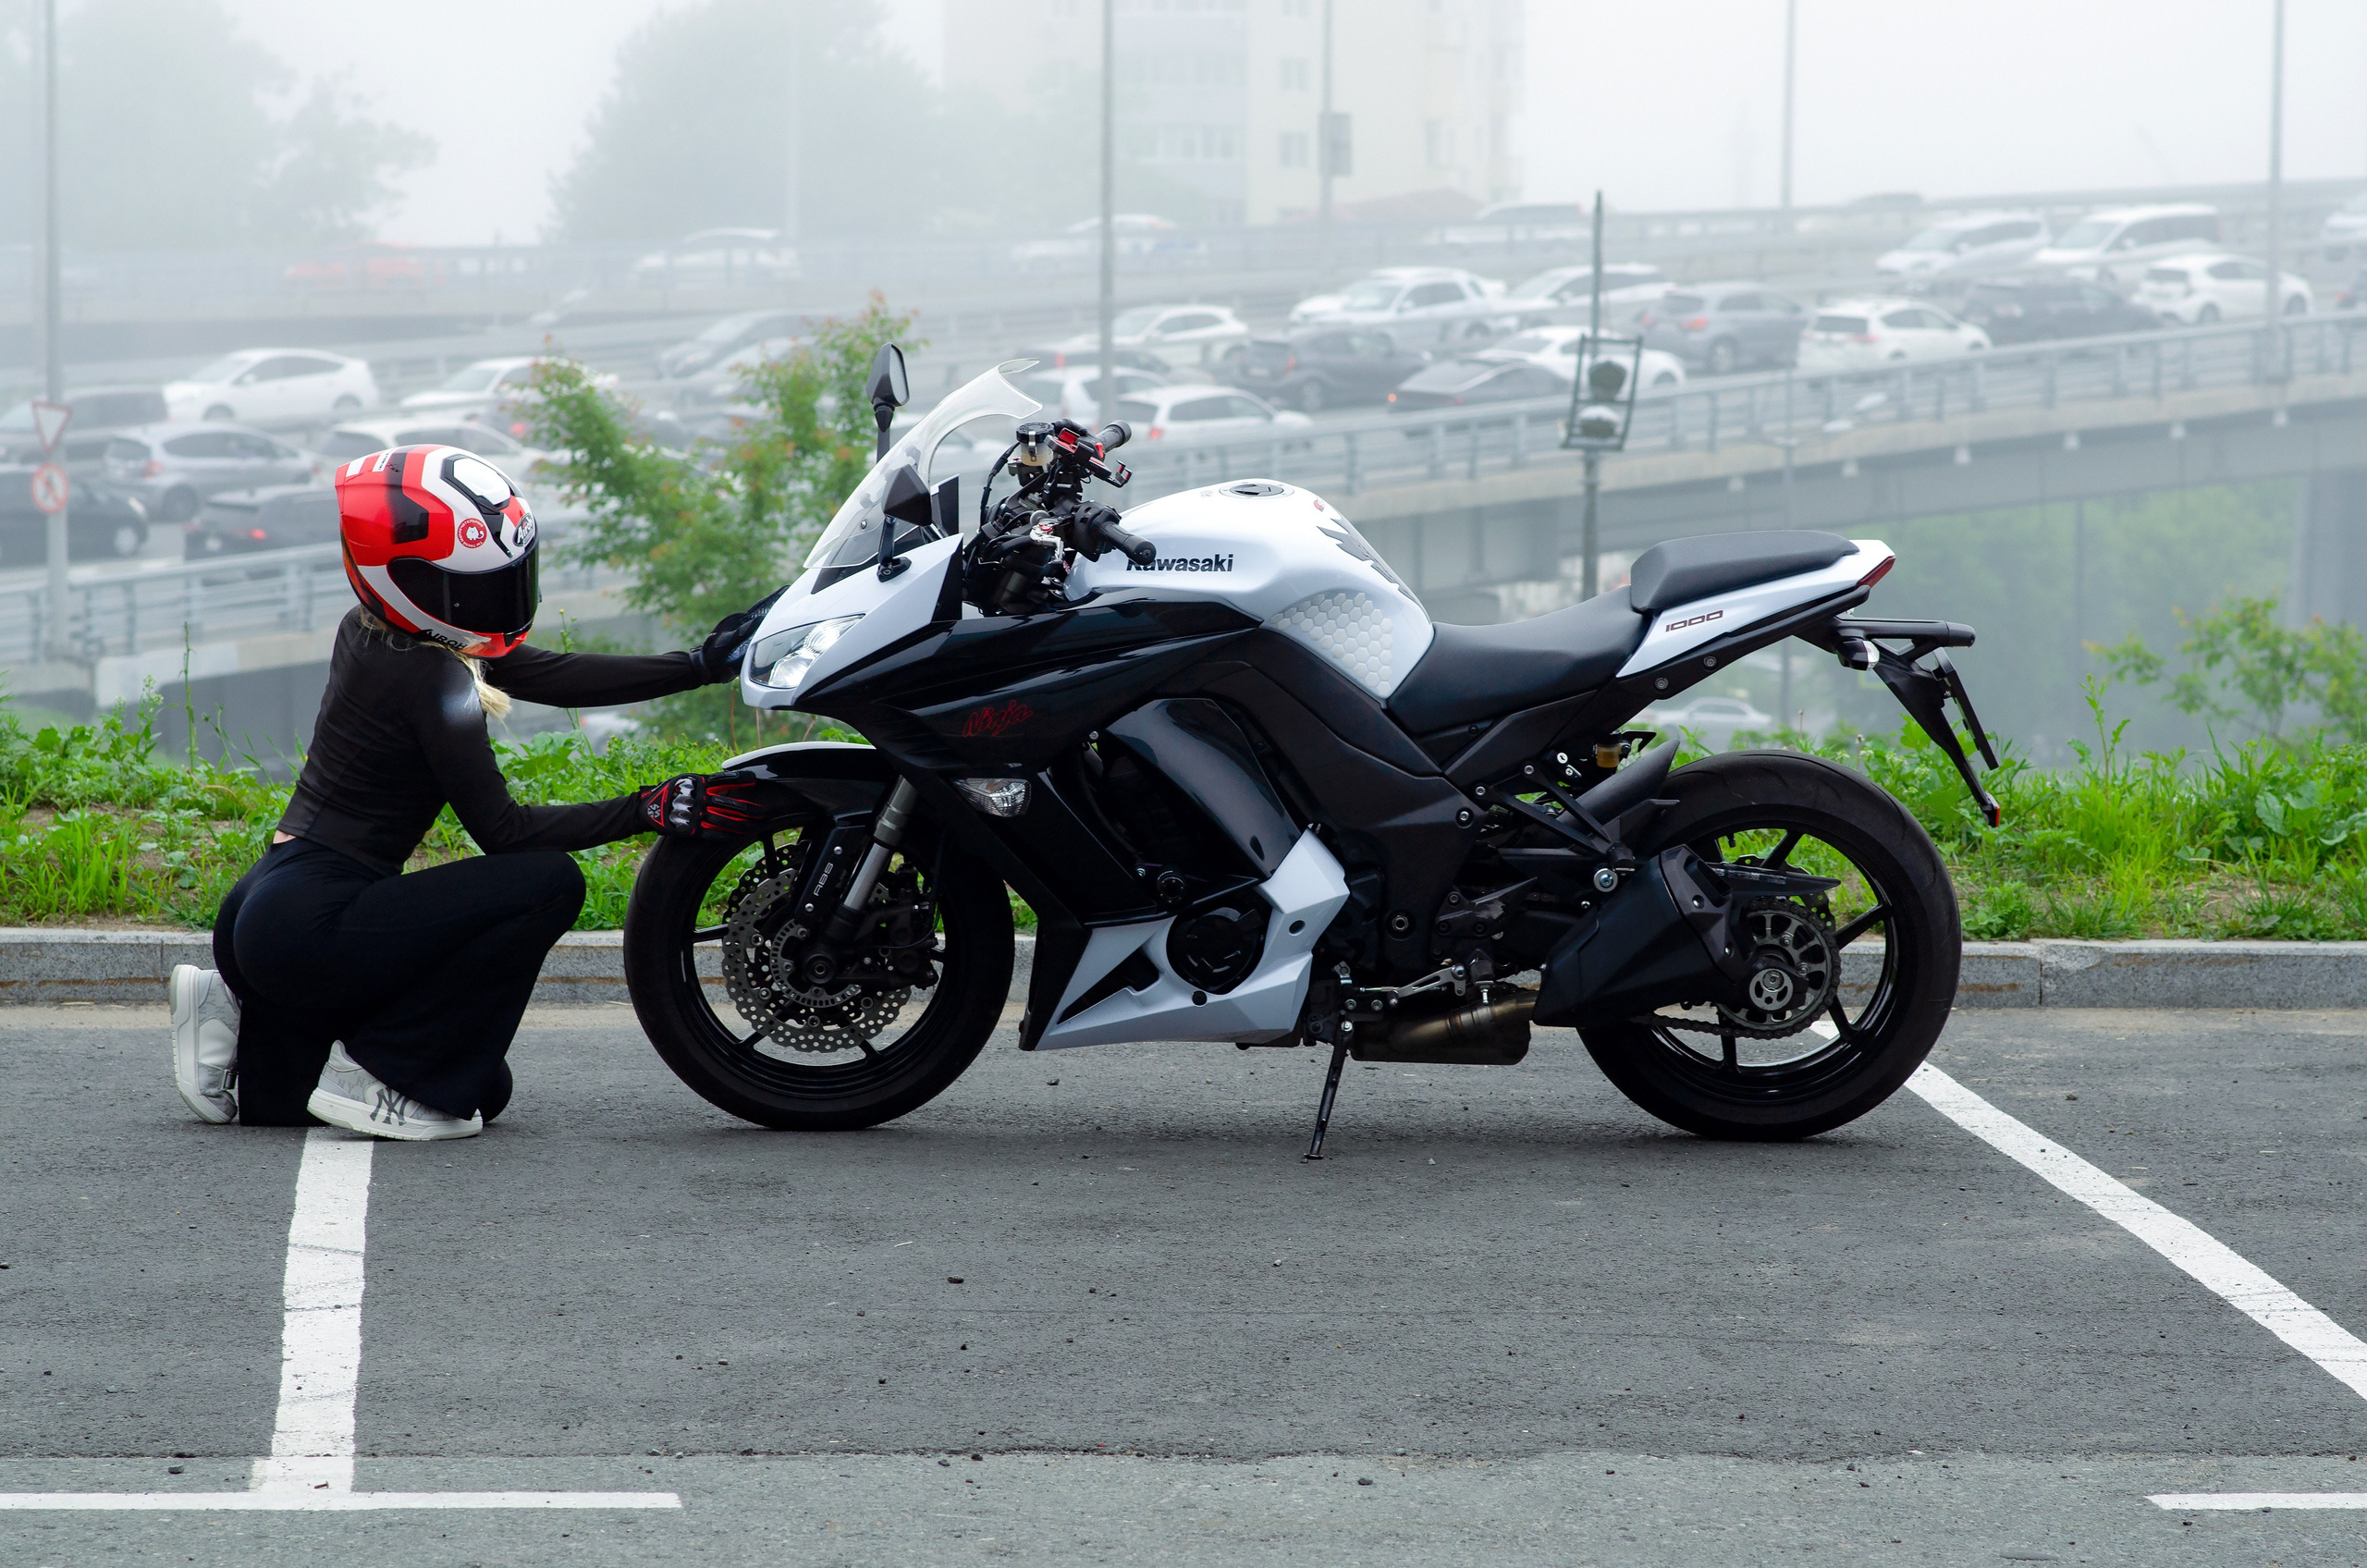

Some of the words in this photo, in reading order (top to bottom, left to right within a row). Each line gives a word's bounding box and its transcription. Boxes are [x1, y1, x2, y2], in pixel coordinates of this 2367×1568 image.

[1665, 610, 1723, 632] 1000
[963, 700, 1034, 737] Ninja
[814, 862, 834, 897] ABS
